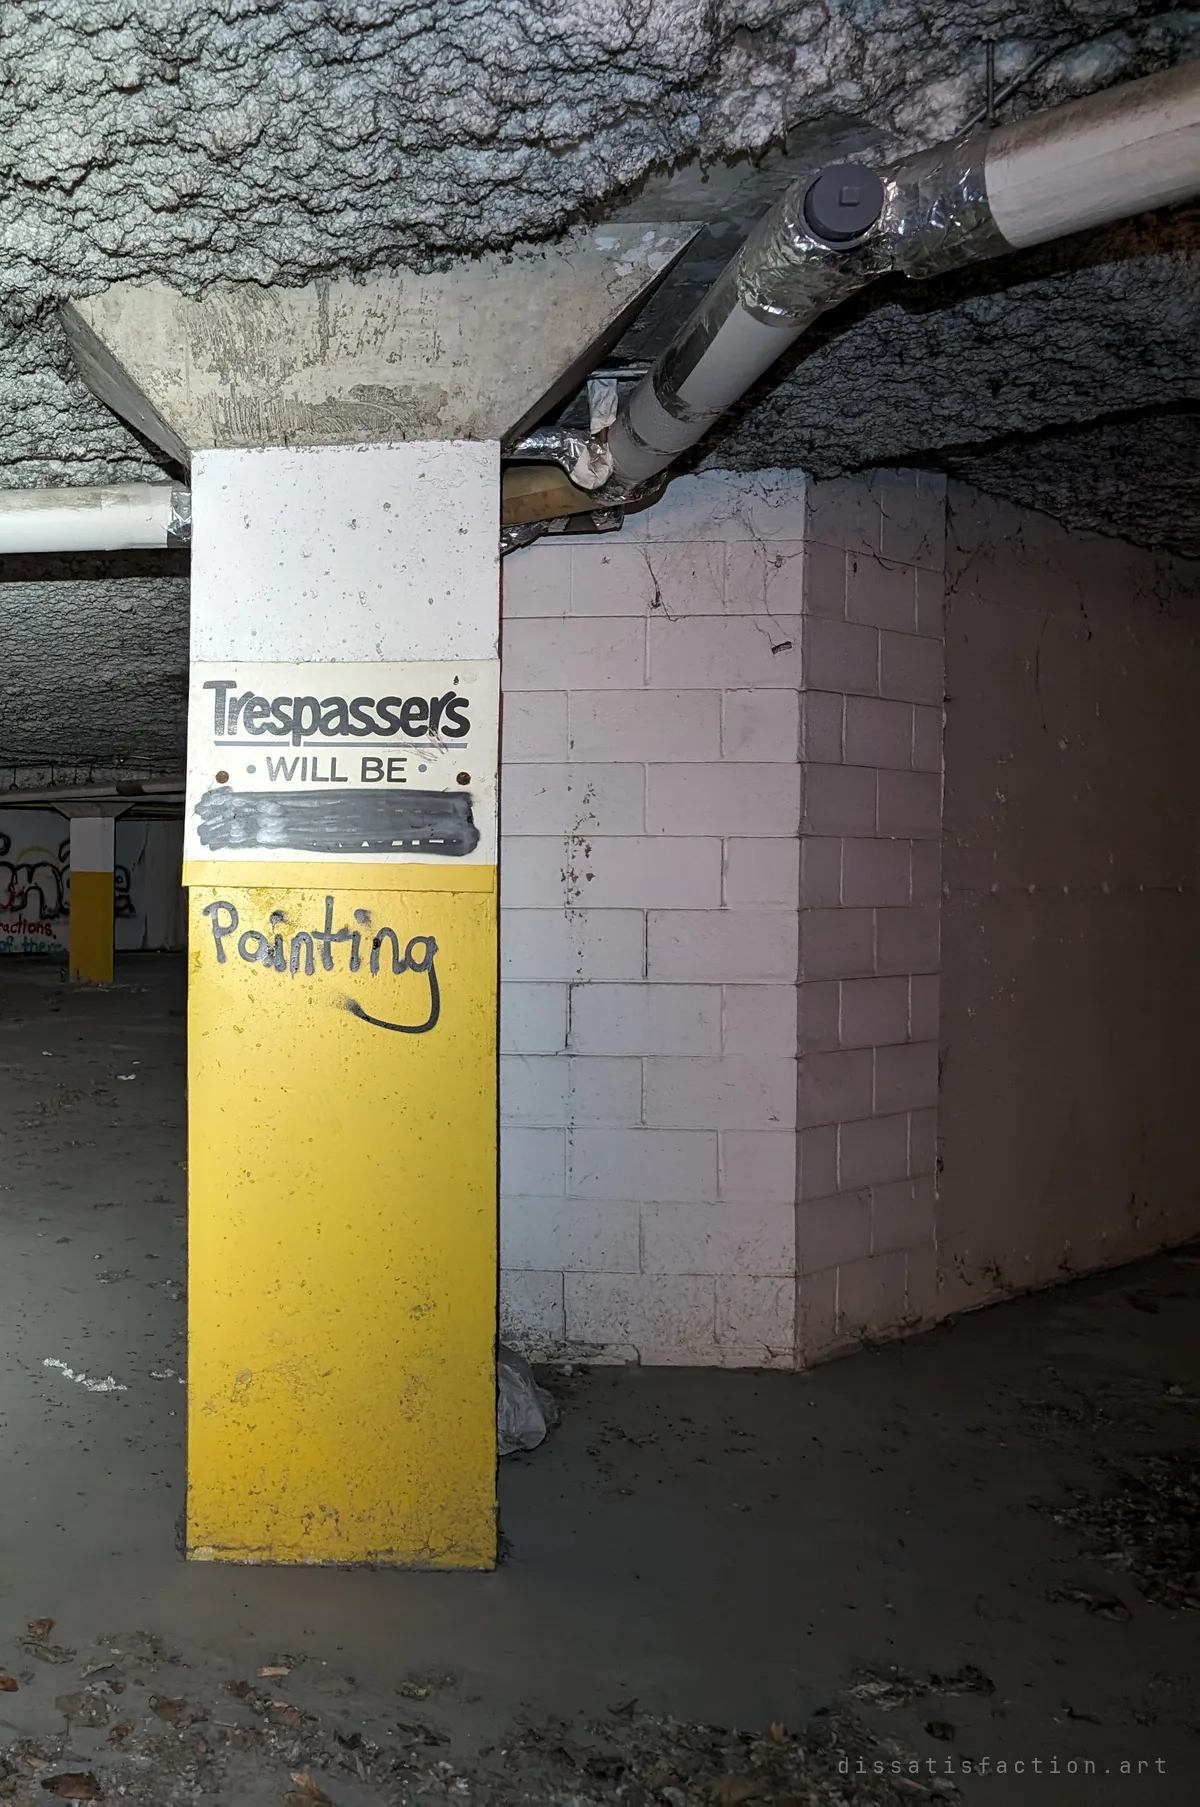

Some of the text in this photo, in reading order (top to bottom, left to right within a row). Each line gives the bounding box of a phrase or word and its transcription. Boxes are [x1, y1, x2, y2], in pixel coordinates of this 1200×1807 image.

[203, 680, 471, 747] Trespassers
[266, 756, 408, 783] WILL BE
[202, 896, 440, 1034] Painting
